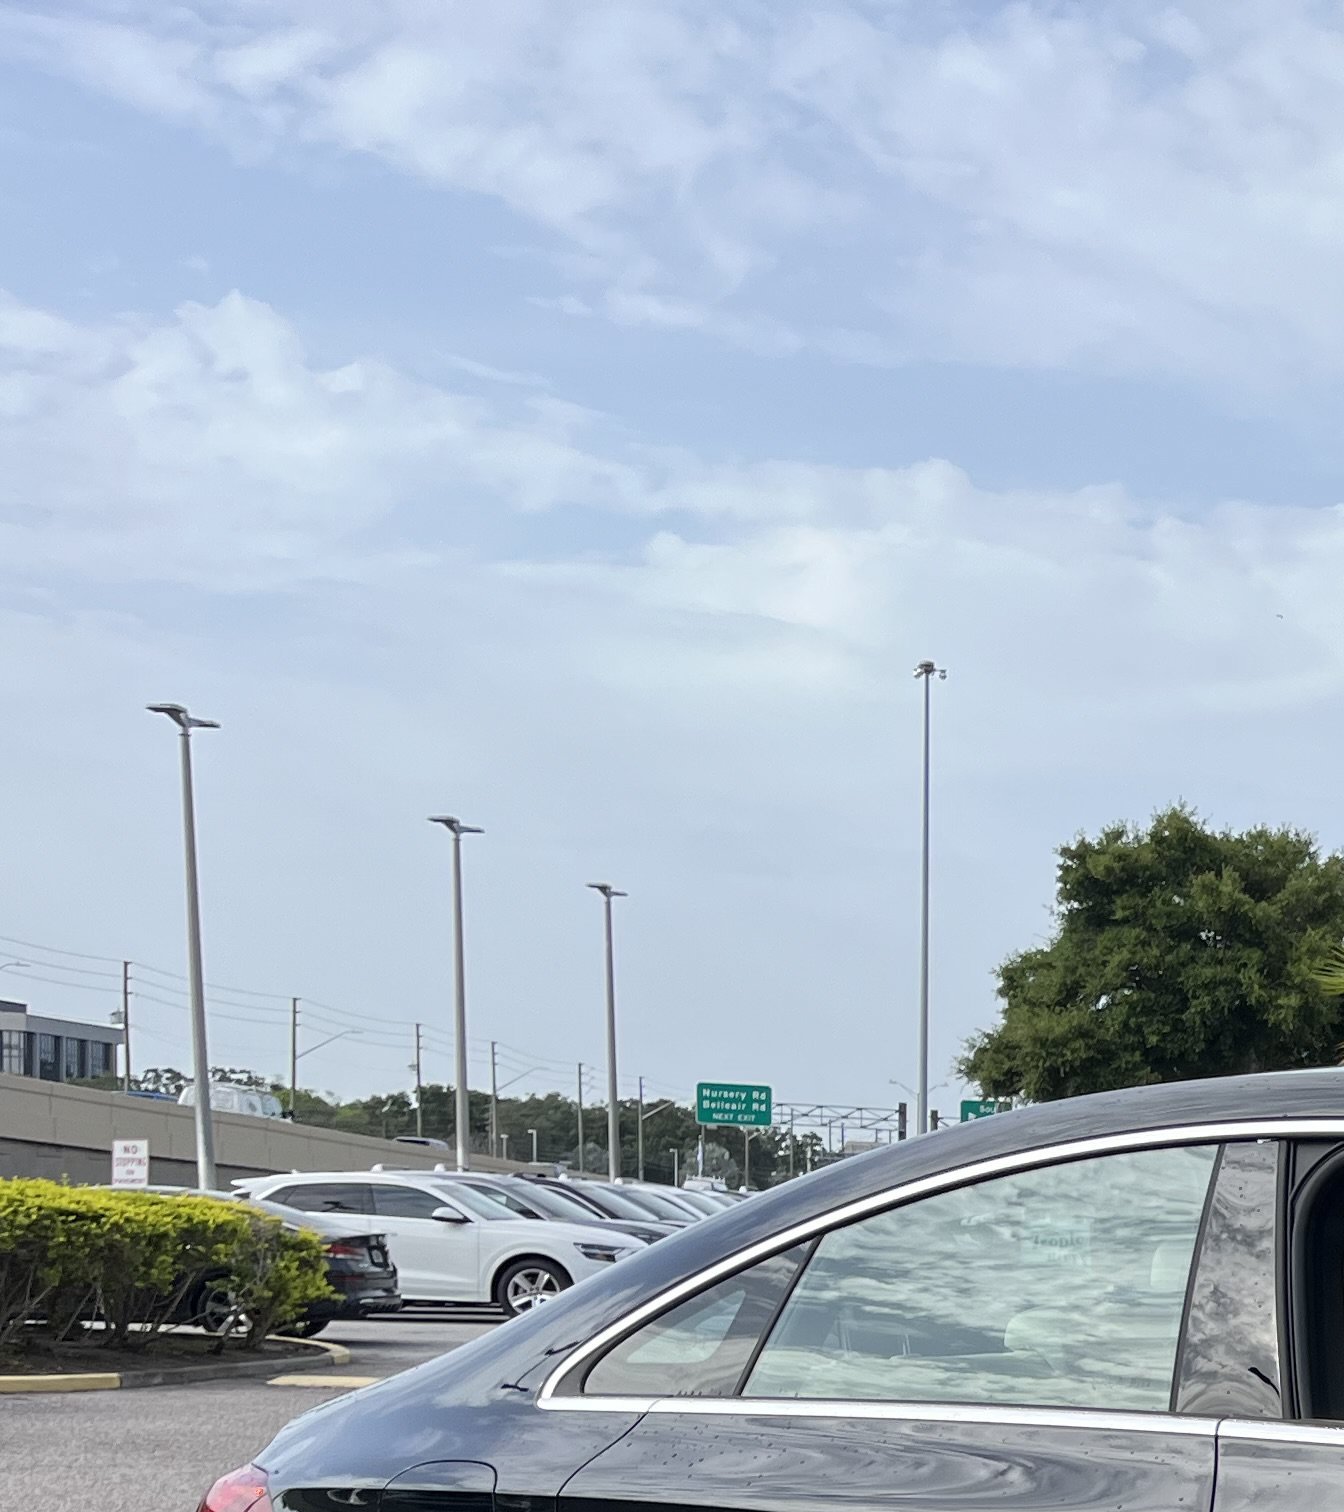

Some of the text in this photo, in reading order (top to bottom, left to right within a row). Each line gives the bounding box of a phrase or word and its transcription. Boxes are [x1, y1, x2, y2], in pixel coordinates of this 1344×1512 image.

[702, 1088, 767, 1101] Nursery Rd
[752, 1102, 767, 1112] Rd
[712, 1113, 756, 1122] NEXT EXIT
